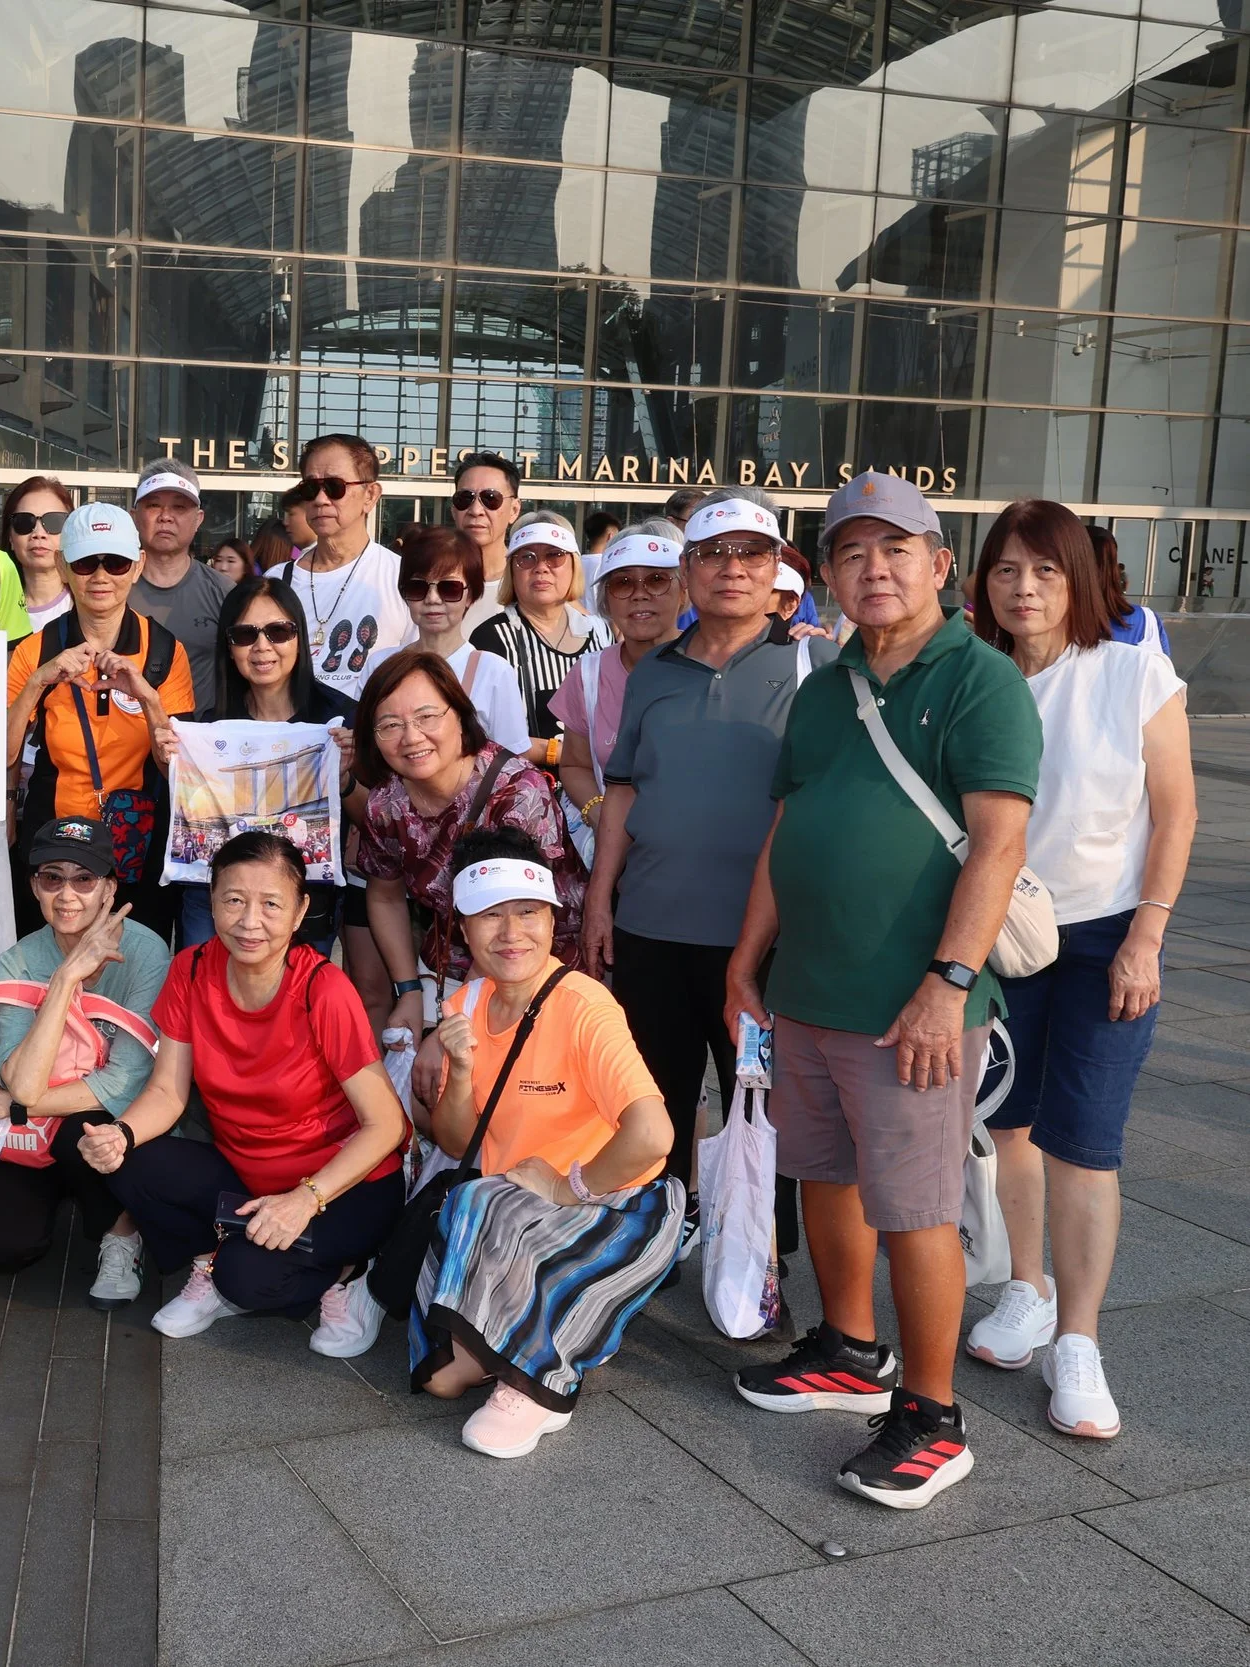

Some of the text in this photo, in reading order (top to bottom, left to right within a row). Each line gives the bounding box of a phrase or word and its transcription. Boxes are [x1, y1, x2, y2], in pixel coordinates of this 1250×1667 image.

[159, 437, 246, 469] THE
[273, 441, 472, 475] SPPE
[557, 453, 717, 484] MARINA
[739, 459, 810, 488] BAY
